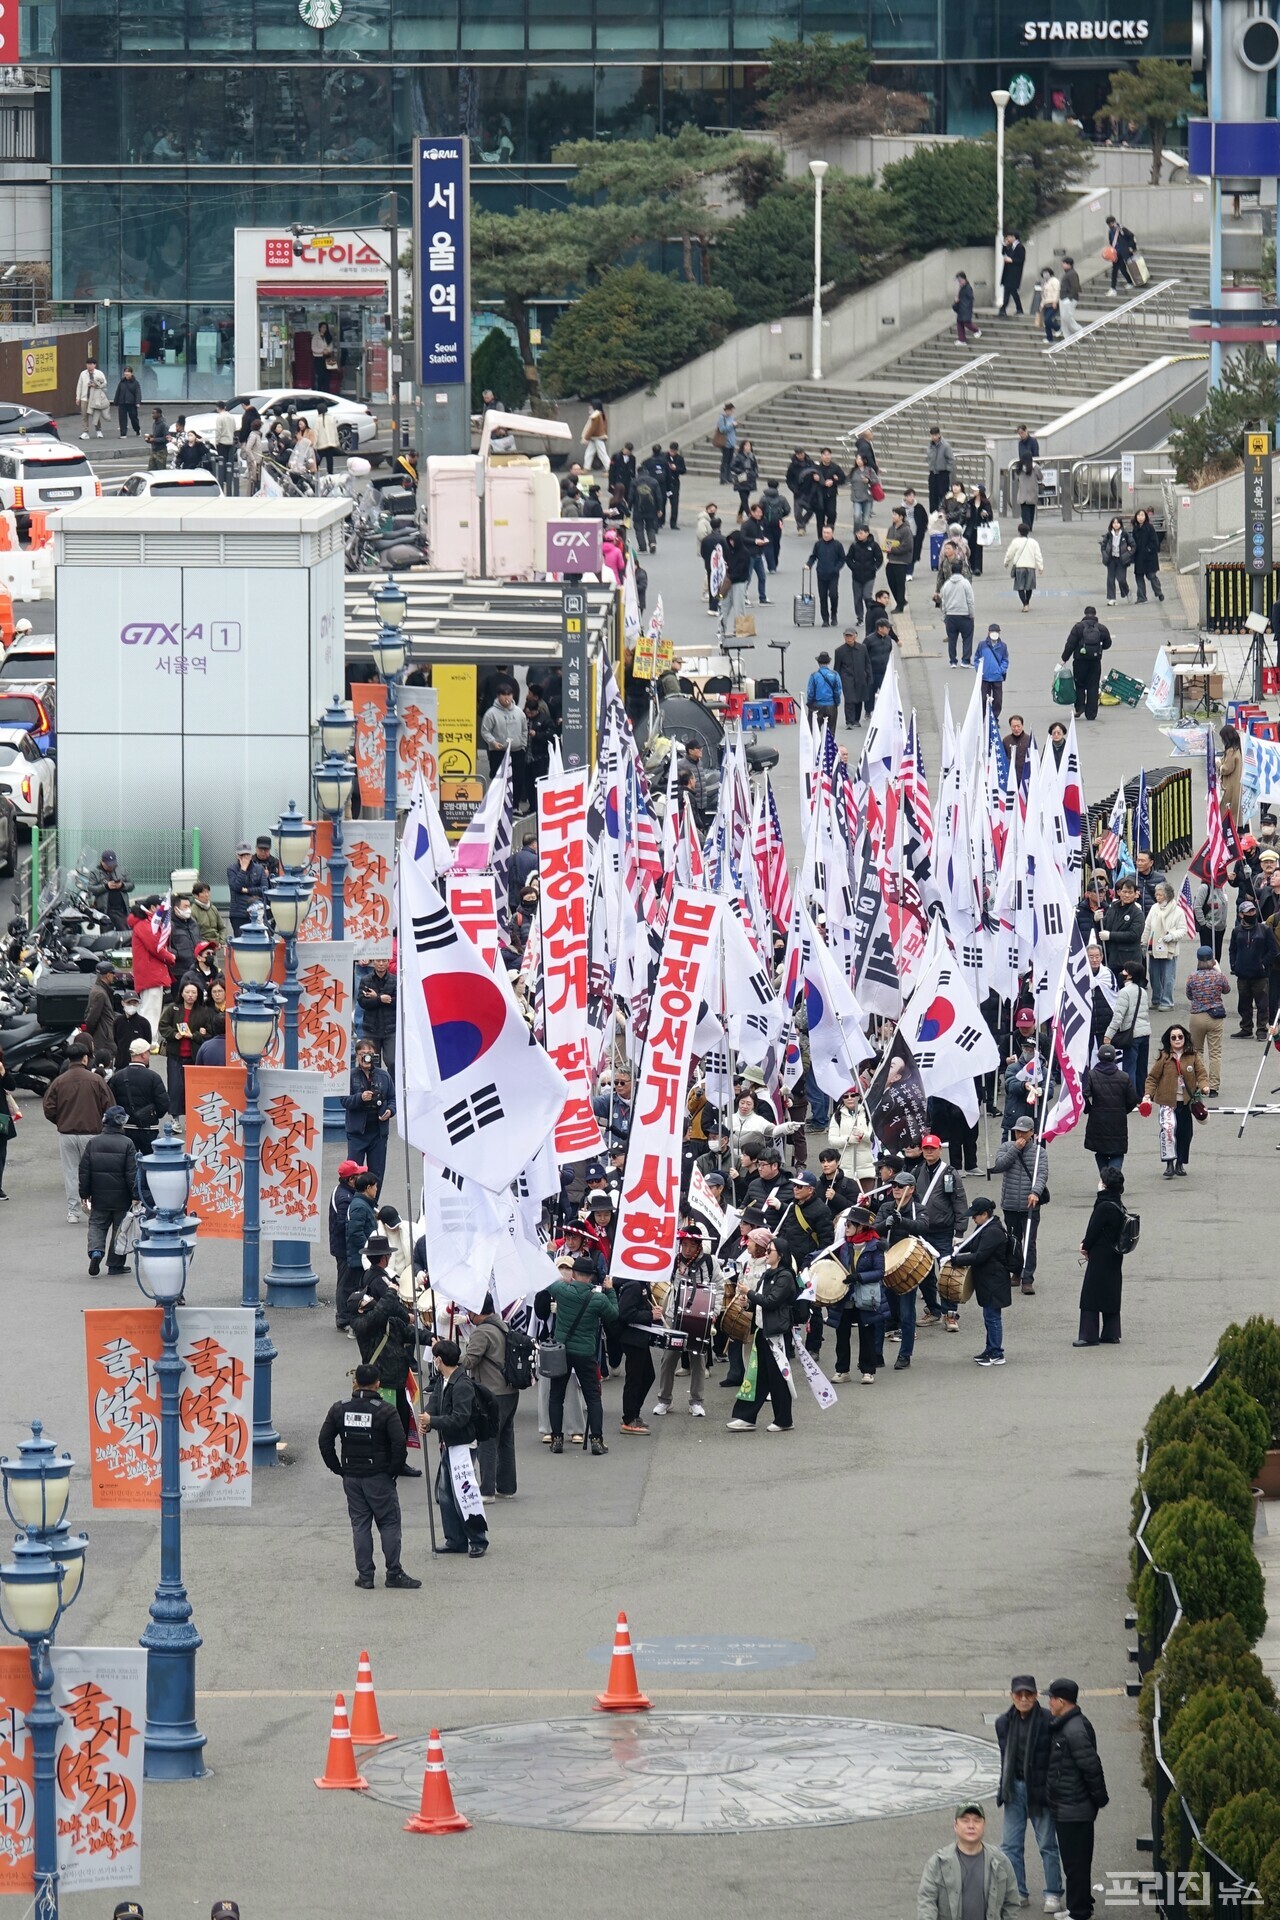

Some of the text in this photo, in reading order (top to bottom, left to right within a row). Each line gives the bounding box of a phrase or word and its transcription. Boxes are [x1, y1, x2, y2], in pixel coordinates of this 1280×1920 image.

[1024, 20, 1149, 41] STARBUCKS
[423, 148, 458, 160] KORAIL
[268, 256, 290, 264] daiso
[300, 243, 381, 265] 다이소
[428, 182, 456, 322] 서울역
[35, 352, 54, 365] 금연구역
[429, 353, 457, 364] Station
[434, 342, 457, 352] Seoul
[1255, 456, 1260, 467] 1
[1254, 476, 1264, 508] 서울역
[552, 530, 591, 547] GTX
[566, 549, 578, 564] A
[120, 622, 228, 646] GTX-A 1
[572, 620, 576, 630] 1
[154, 655, 208, 676] 서울역
[568, 656, 581, 702] 서울역
[540, 782, 588, 1014] 부정선거
[298, 964, 350, 1014] 글자
[640, 898, 717, 1135] 부정선거
[193, 1091, 244, 1146] 글자
[264, 1094, 320, 1151] 글자
[191, 1133, 244, 1200] (감각)
[261, 1136, 318, 1203] (감각)
[260, 1185, 281, 1200] 2025.
[620, 1154, 679, 1272] 사형
[96, 1337, 161, 1400] 글자
[182, 1336, 250, 1400] 글자
[94, 1386, 161, 1462] (감각)
[180, 1386, 248, 1460] (감각)
[96, 1444, 122, 1462] 2025.
[107, 1448, 139, 1470] 11.19.
[180, 1444, 204, 1462] 2025.
[190, 1448, 222, 1472] 11.19.
[210, 1458, 234, 1480] 2026.
[224, 1460, 251, 1484] 3.22.
[60, 1682, 140, 1758] 글자
[57, 1740, 136, 1832] (감각)
[57, 1814, 84, 1836] 2025.
[71, 1816, 104, 1847] 11.19.
[88, 1828, 118, 1855] 2026.
[108, 1831, 138, 1860] 3.22.
